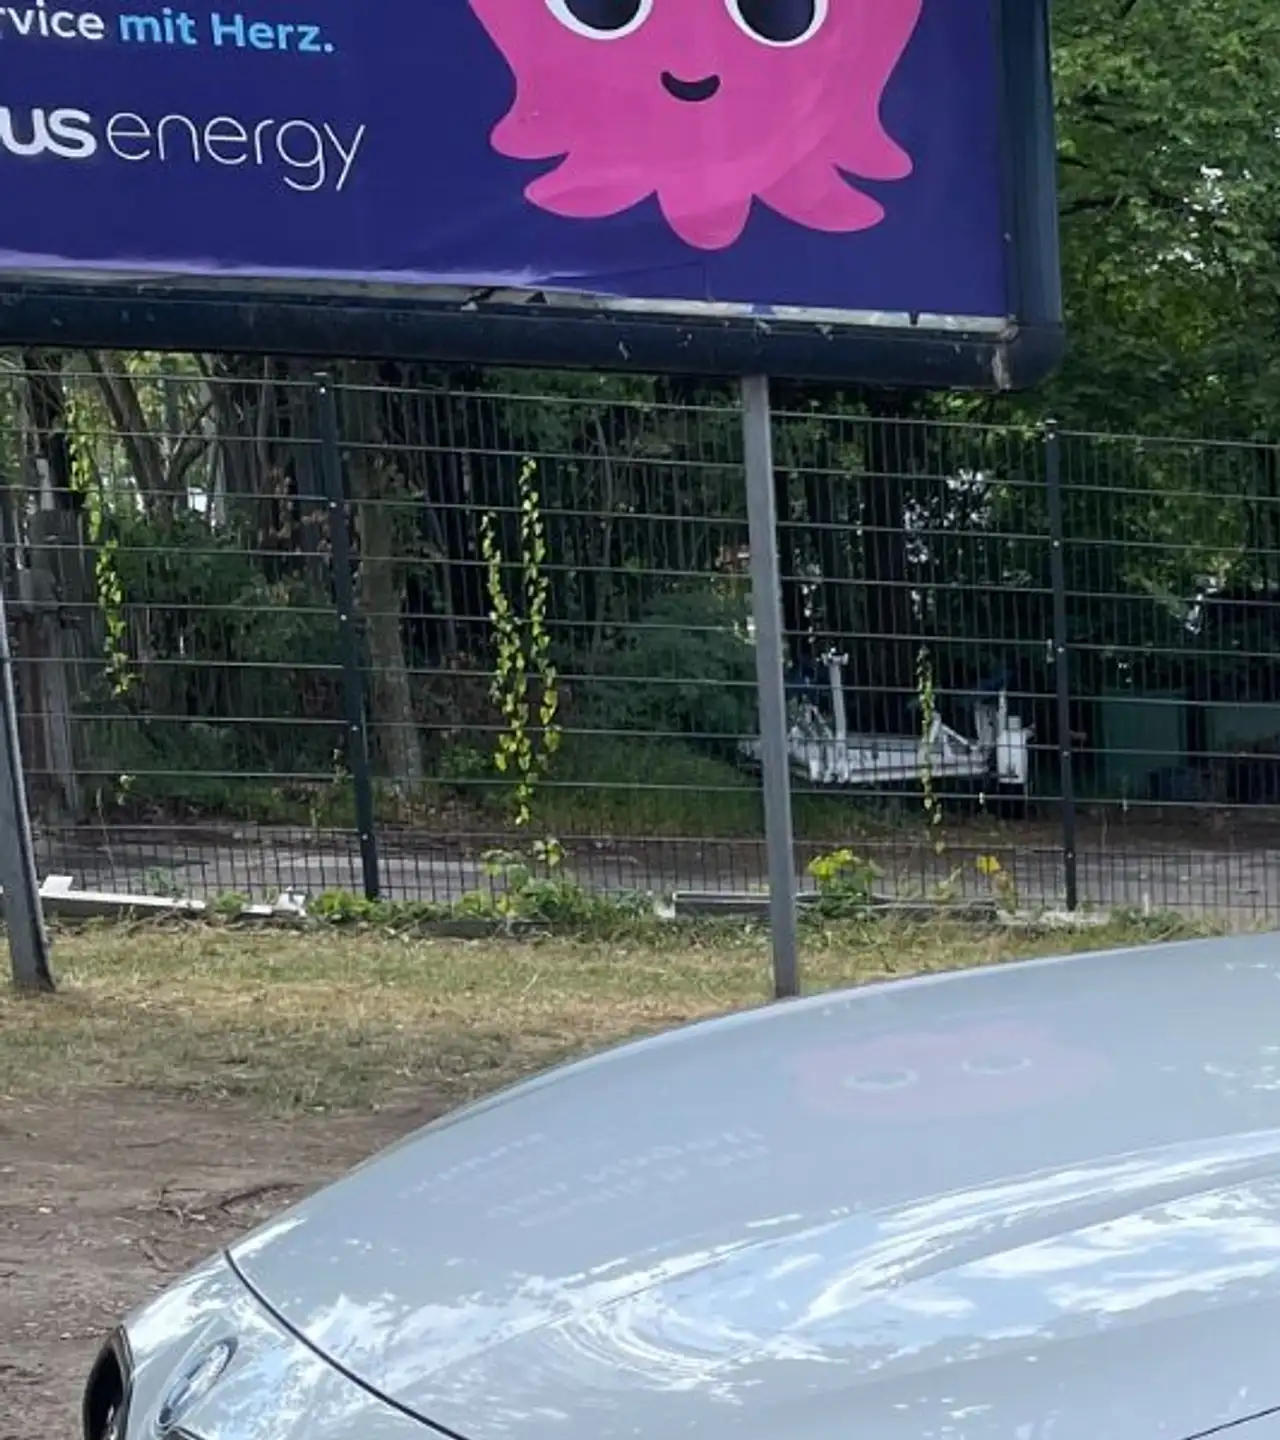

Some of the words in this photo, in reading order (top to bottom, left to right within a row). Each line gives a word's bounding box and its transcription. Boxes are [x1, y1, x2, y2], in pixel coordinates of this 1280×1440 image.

[119, 7, 198, 45] mit
[211, 12, 335, 53] Herz.
[107, 112, 366, 191] energy
